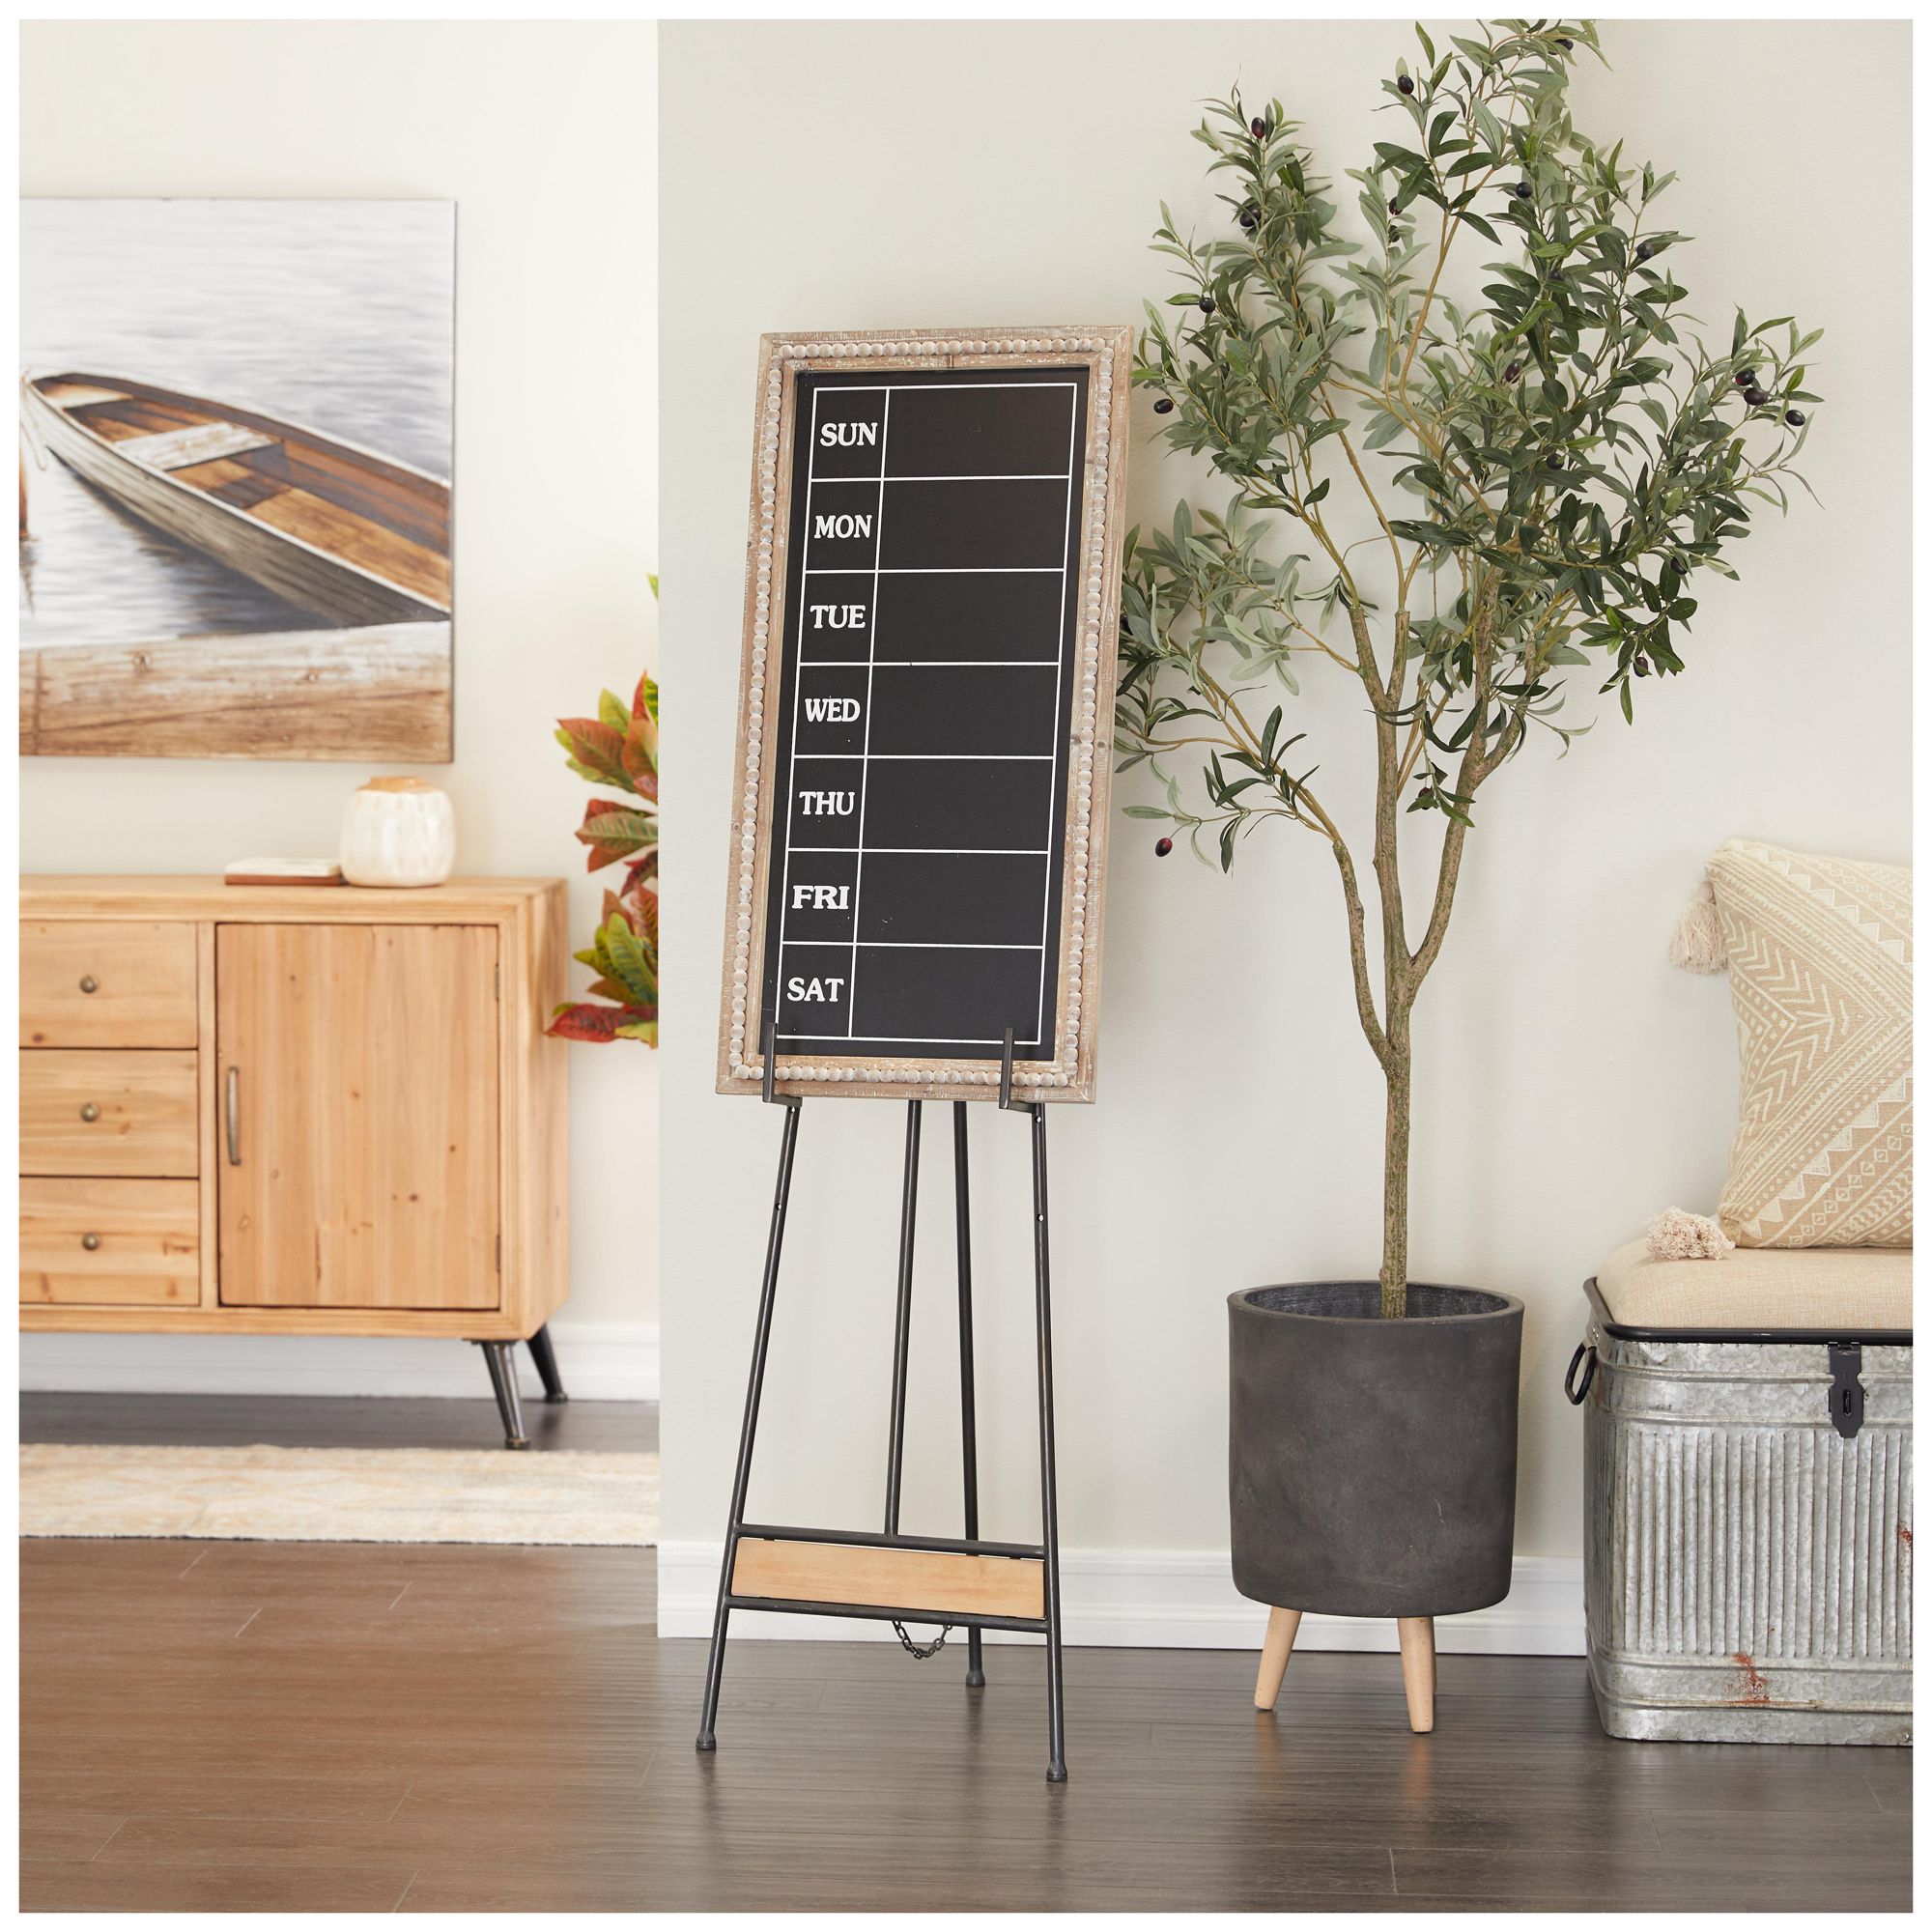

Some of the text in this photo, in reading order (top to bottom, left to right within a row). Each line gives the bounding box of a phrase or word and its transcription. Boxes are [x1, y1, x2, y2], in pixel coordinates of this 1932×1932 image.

[819, 422, 878, 447] SUN
[813, 514, 872, 539] MON
[809, 604, 867, 629] TUE
[804, 697, 861, 723] WED
[799, 790, 855, 816] THU
[791, 884, 851, 910] FRI
[786, 977, 845, 1003] SAT
